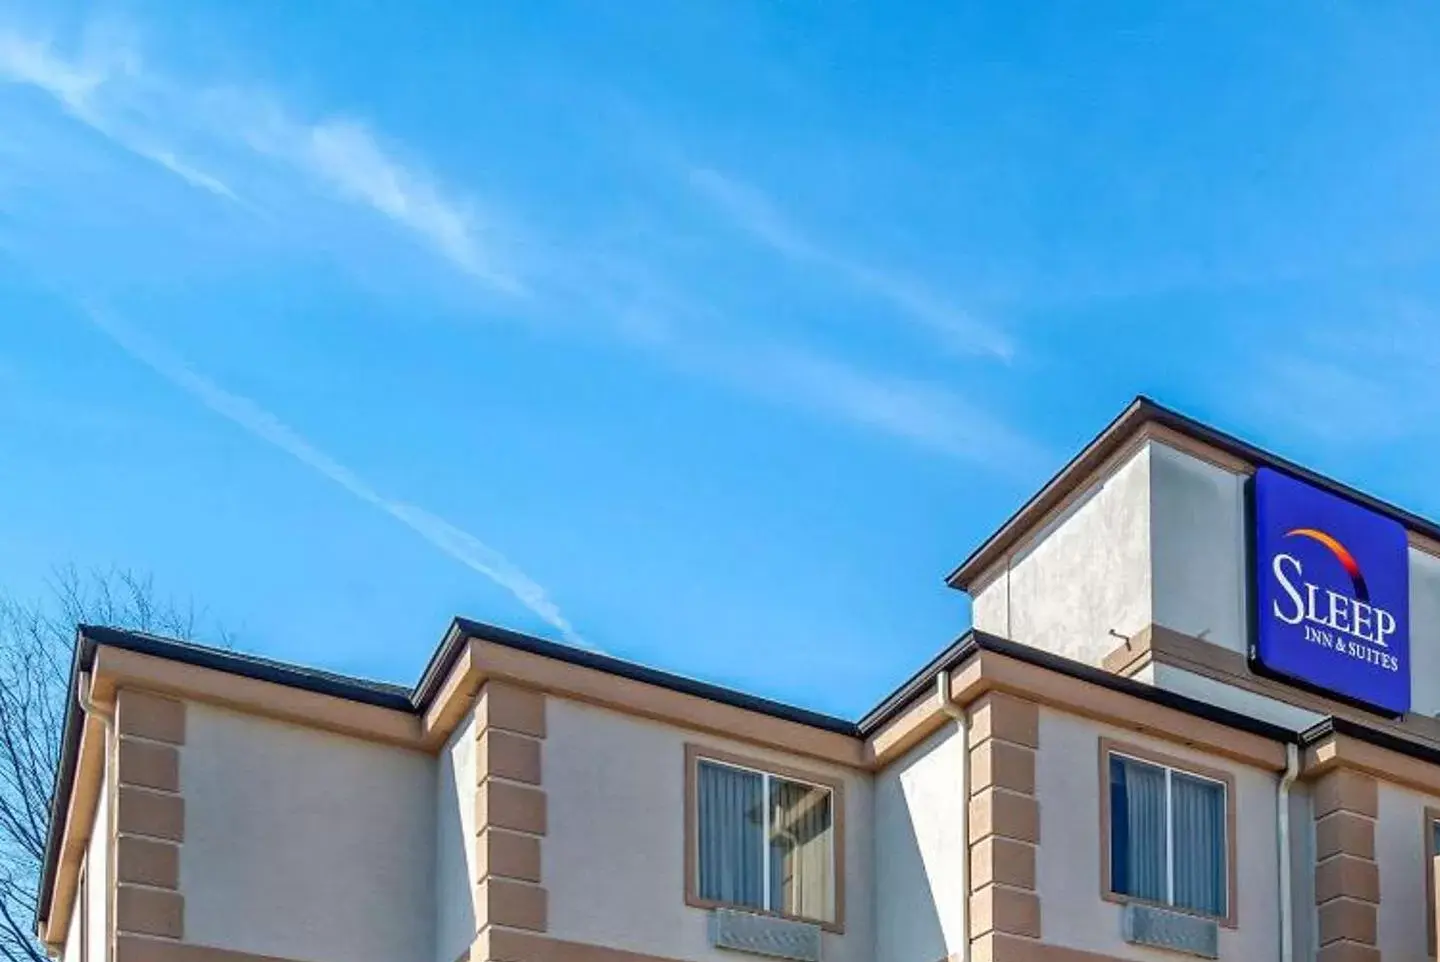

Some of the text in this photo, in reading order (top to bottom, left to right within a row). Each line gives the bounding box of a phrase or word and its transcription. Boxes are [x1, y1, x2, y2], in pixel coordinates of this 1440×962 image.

[1273, 554, 1396, 647] SLEEP
[1304, 626, 1399, 672] INN & SUITES
